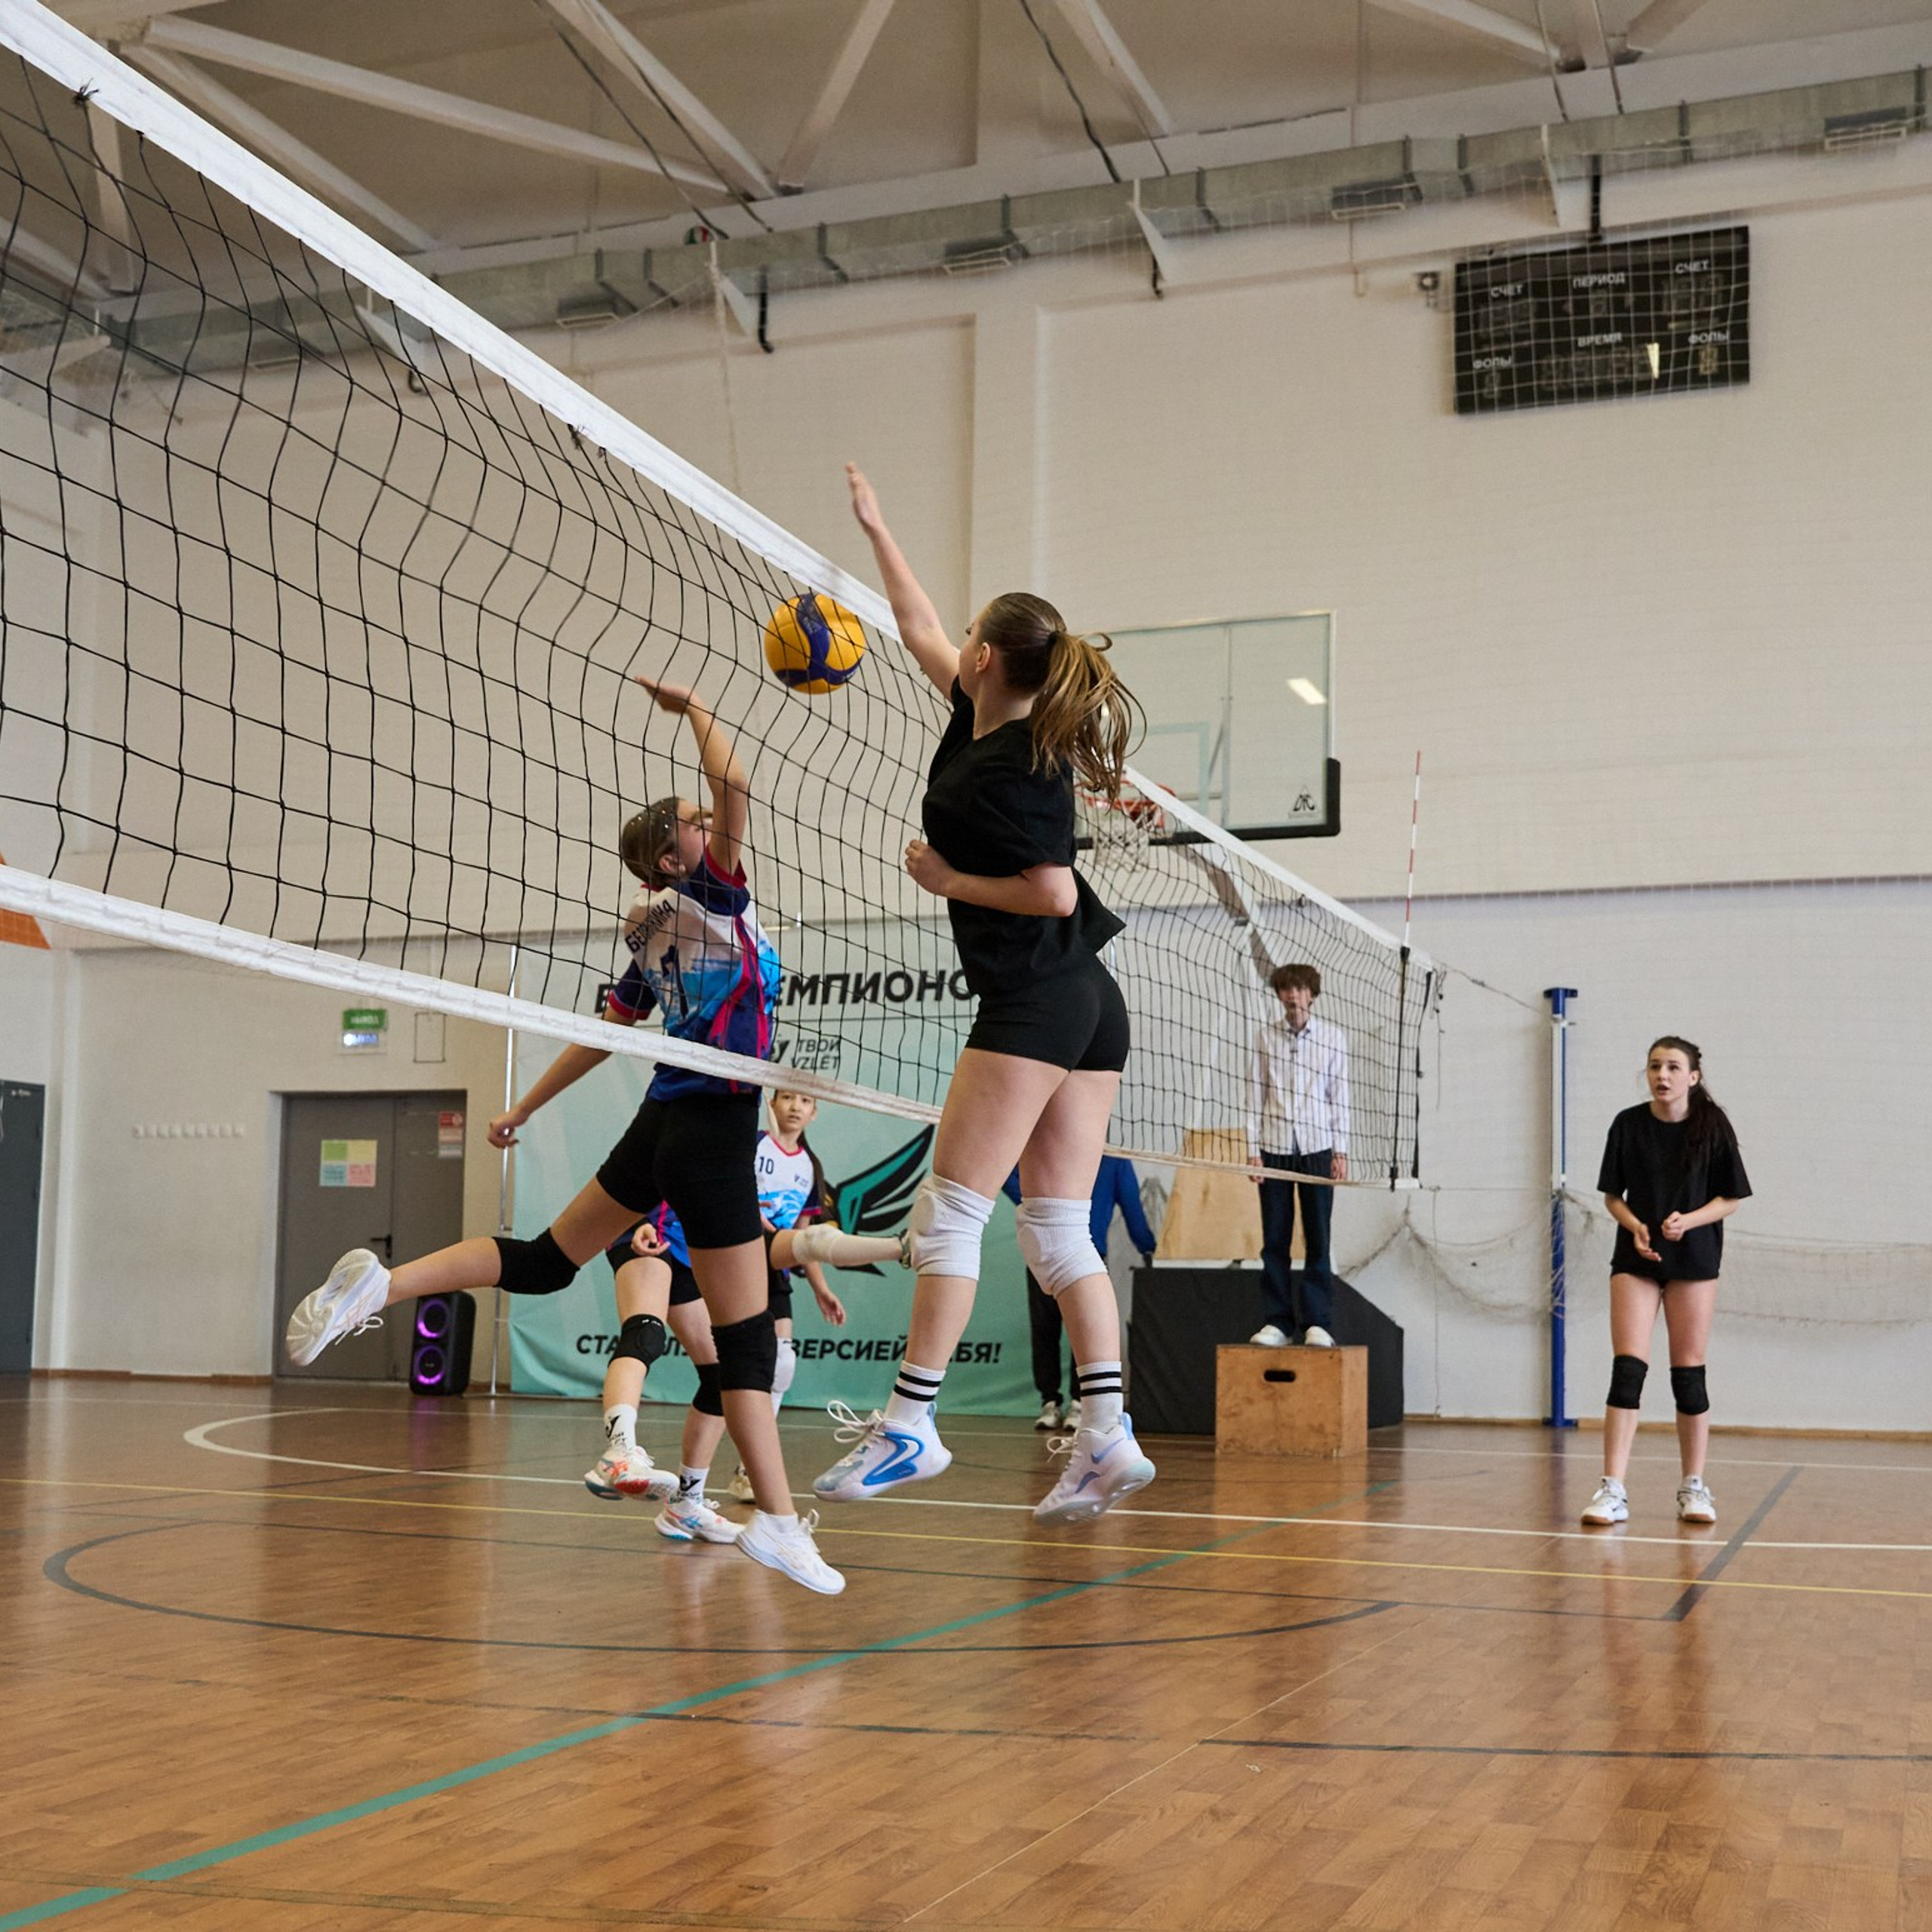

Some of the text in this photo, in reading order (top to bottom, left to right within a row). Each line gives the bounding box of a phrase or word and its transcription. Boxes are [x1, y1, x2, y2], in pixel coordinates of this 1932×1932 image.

[1675, 259, 1709, 274] СЧЕТ
[1573, 272, 1625, 288] ПЕРИОД
[1491, 284, 1523, 298] СЧЕТ
[1577, 333, 1622, 347] ВРЕМЯ
[1687, 331, 1730, 344] ФОЛЫ
[759, 1156, 775, 1174] 10
[576, 1336, 620, 1355] СТА
[949, 1341, 1001, 1363] БЯ!
